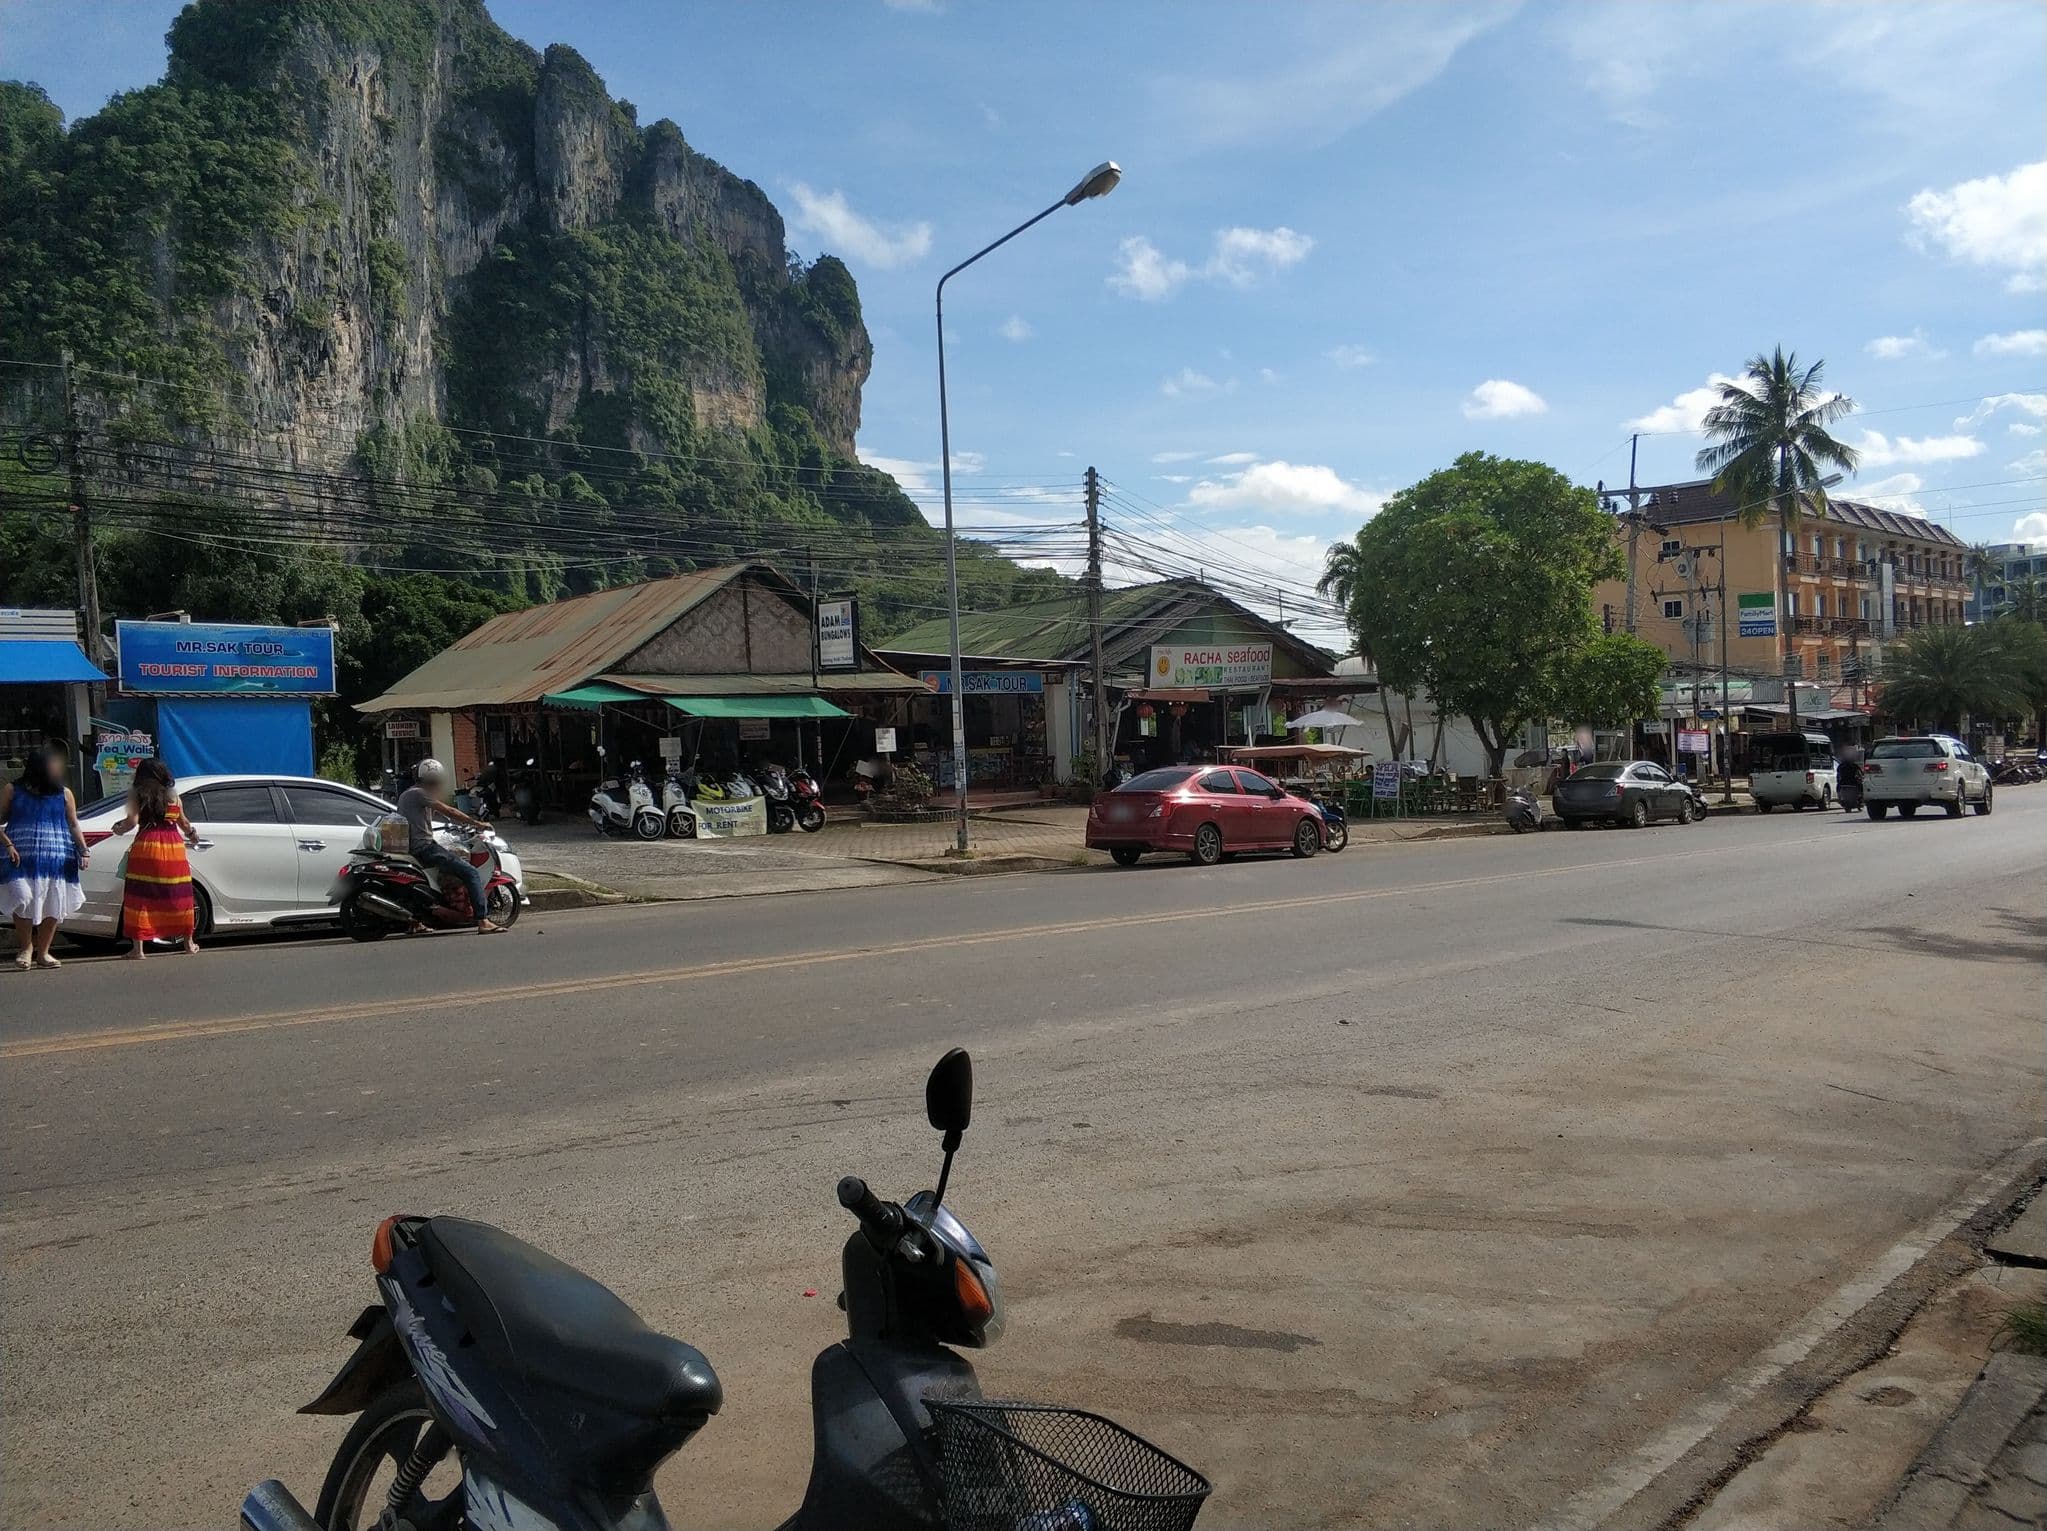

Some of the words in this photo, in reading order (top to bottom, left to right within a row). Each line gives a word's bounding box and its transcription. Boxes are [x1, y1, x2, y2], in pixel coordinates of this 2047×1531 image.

[821, 615, 840, 628] ADAM
[821, 629, 851, 640] BUNGALOWS
[176, 641, 238, 654] MR.SAK
[244, 643, 284, 655] TOUR
[1184, 652, 1222, 665] RACHA
[1227, 647, 1270, 663] seafood
[139, 664, 207, 677] TOURIST
[213, 665, 318, 678] INFORMATION
[1223, 665, 1270, 674] RESTAURANT
[996, 677, 1028, 690] TOUR
[98, 744, 119, 753] Tea
[705, 805, 753, 815] MOTORBIKE
[698, 822, 713, 830] FOR
[717, 821, 738, 829] RENT
